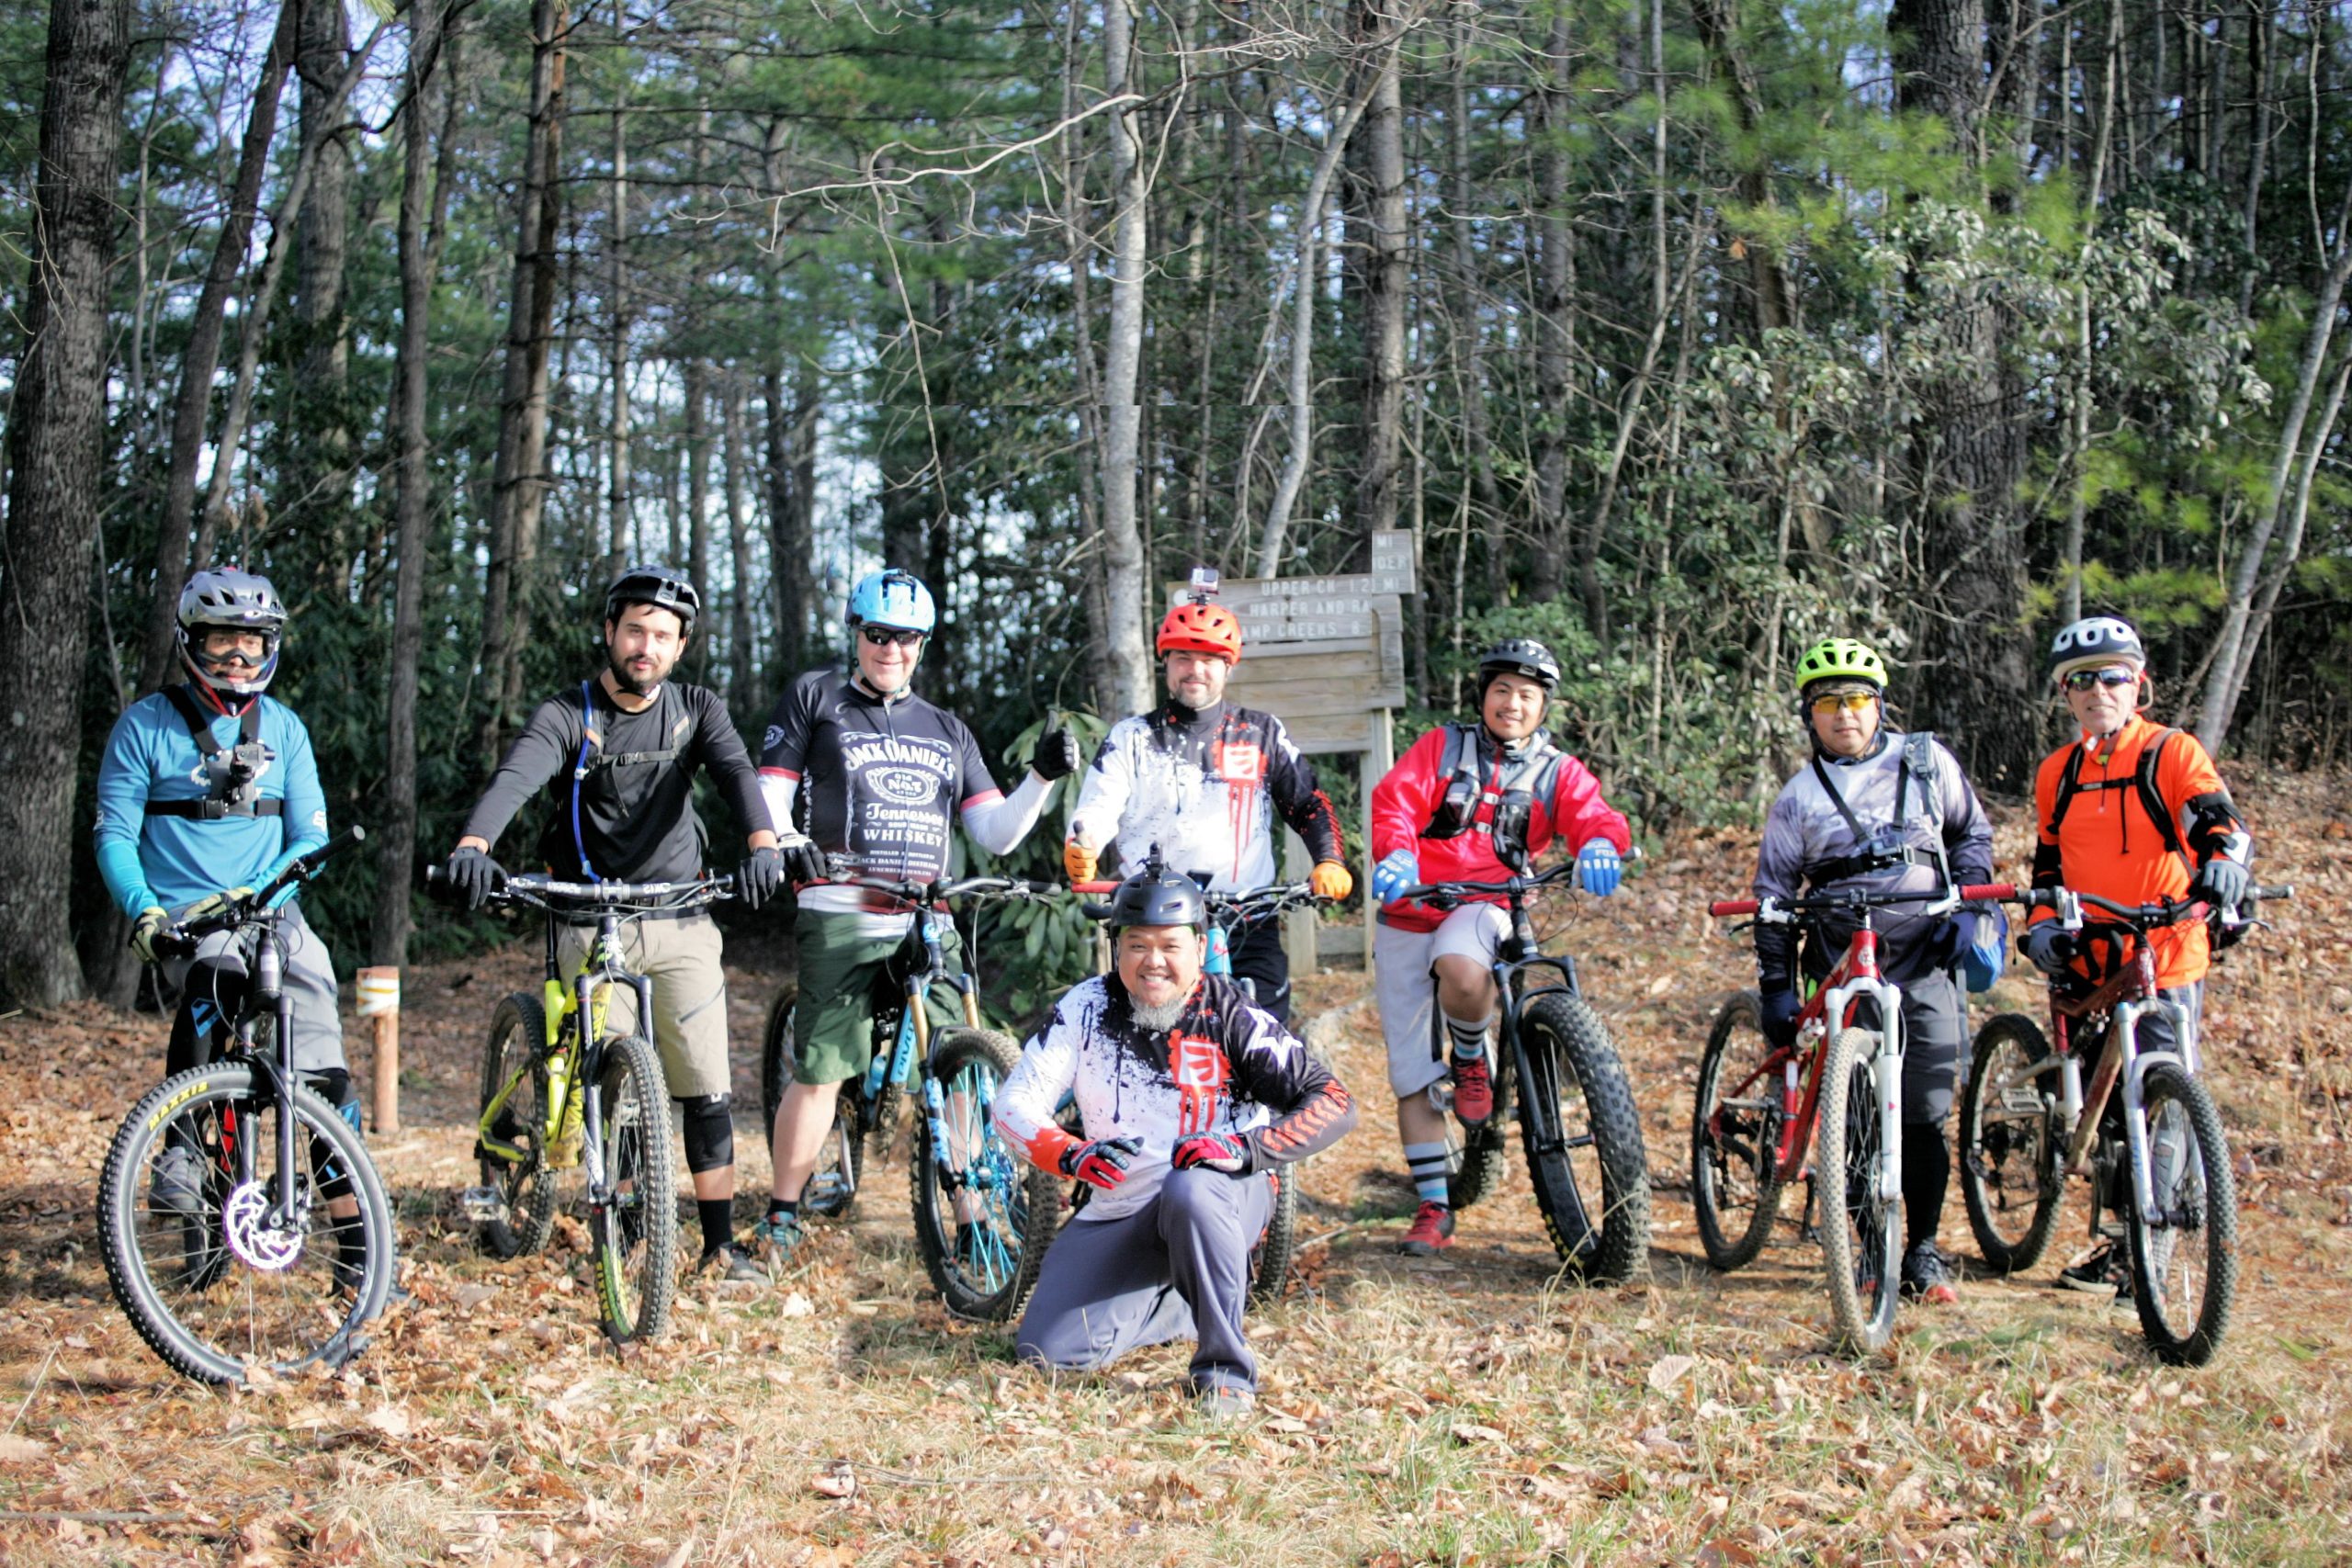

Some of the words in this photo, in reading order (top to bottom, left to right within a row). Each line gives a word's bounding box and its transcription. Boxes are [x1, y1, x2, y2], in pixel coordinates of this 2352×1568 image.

[1377, 536, 1393, 547] MI
[1261, 580, 1311, 597] UPPER
[1249, 601, 1309, 617] HARPER
[1316, 599, 1345, 615] AND
[1240, 623, 1272, 640] AMP
[1277, 622, 1338, 638] CREEKS
[842, 742, 888, 772] JACK
[865, 803, 944, 827] Tennessee
[863, 829, 944, 847] WHISKEY
[148, 1081, 209, 1132] MAXXIS
